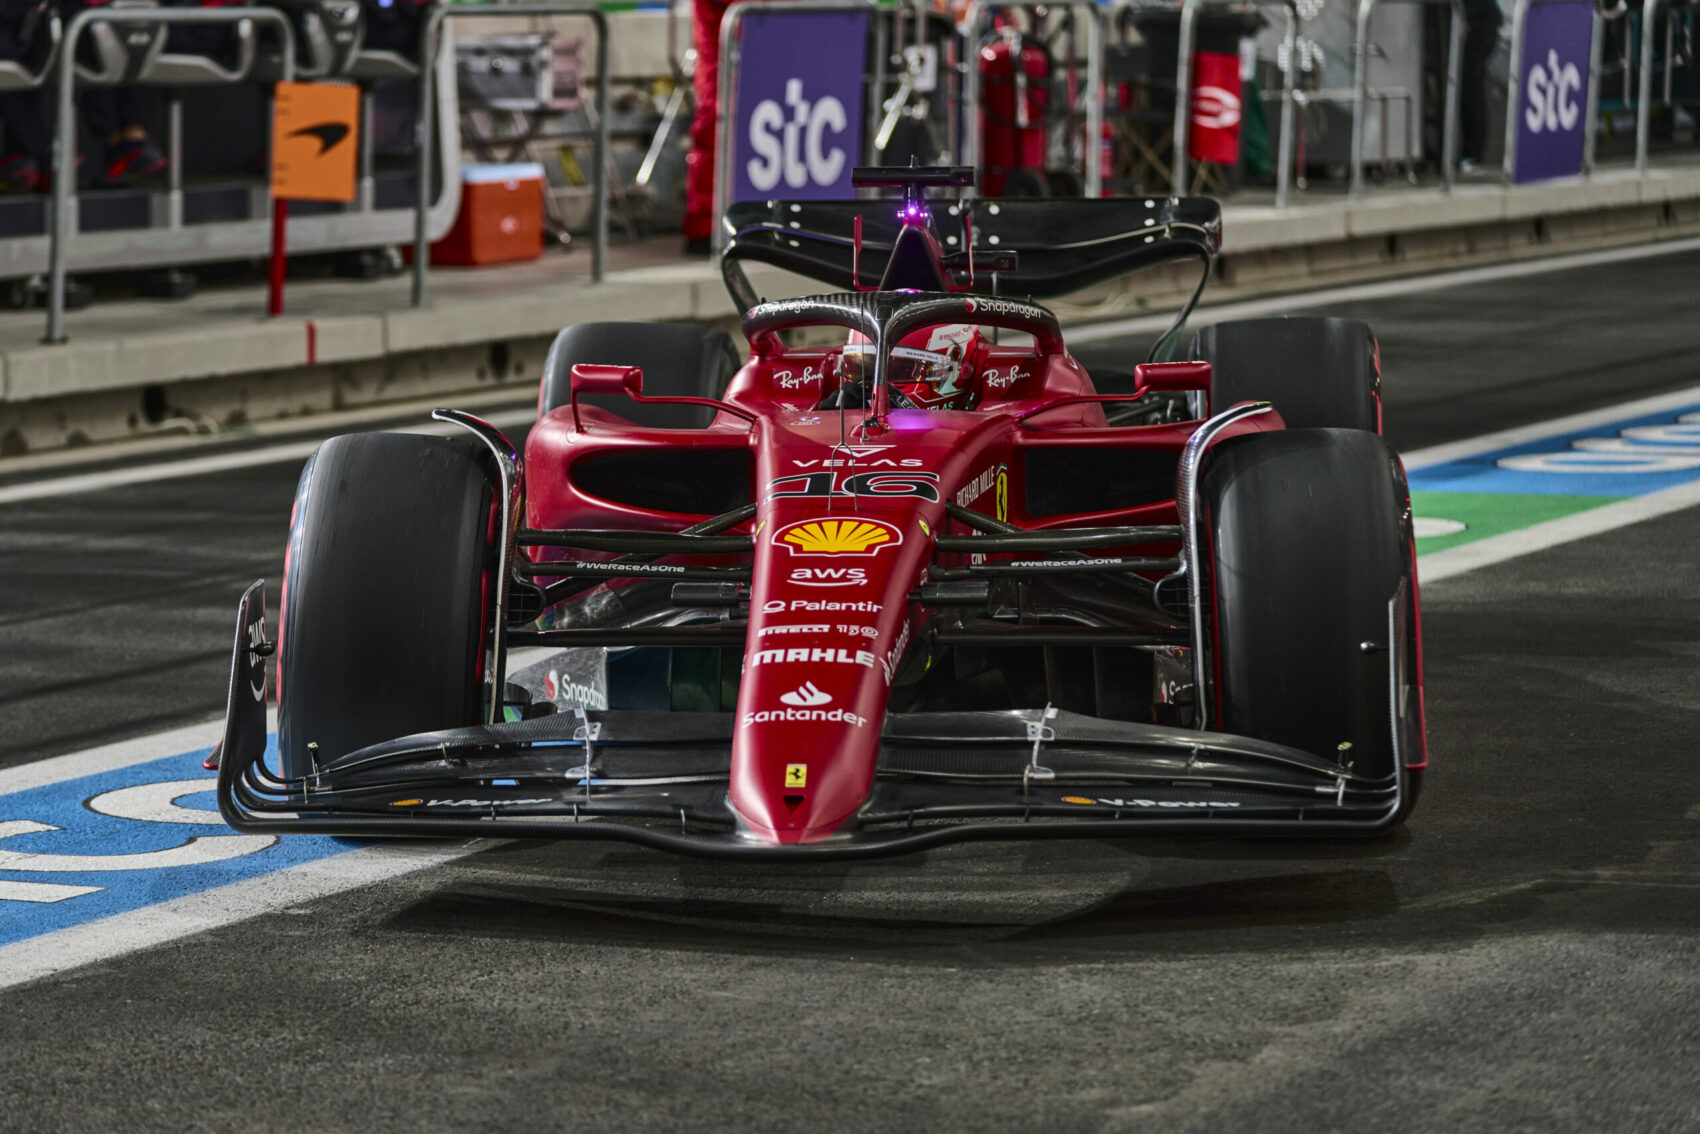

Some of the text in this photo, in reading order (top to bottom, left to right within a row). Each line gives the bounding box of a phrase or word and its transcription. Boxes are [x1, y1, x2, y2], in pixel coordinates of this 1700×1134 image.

[1525, 48, 1580, 133] stc
[747, 78, 847, 191] stc
[980, 300, 1041, 319] Snapdragon
[792, 459, 923, 467] VELAS
[765, 471, 940, 504] 16
[980, 465, 995, 496] MILLE
[576, 561, 685, 573] #WeRaceAsOne
[1011, 558, 1122, 567] #WeRaceAsOne
[791, 568, 866, 579] aws
[790, 600, 882, 613] Palantir
[752, 648, 875, 668] MAHLE
[742, 708, 868, 729] Santander
